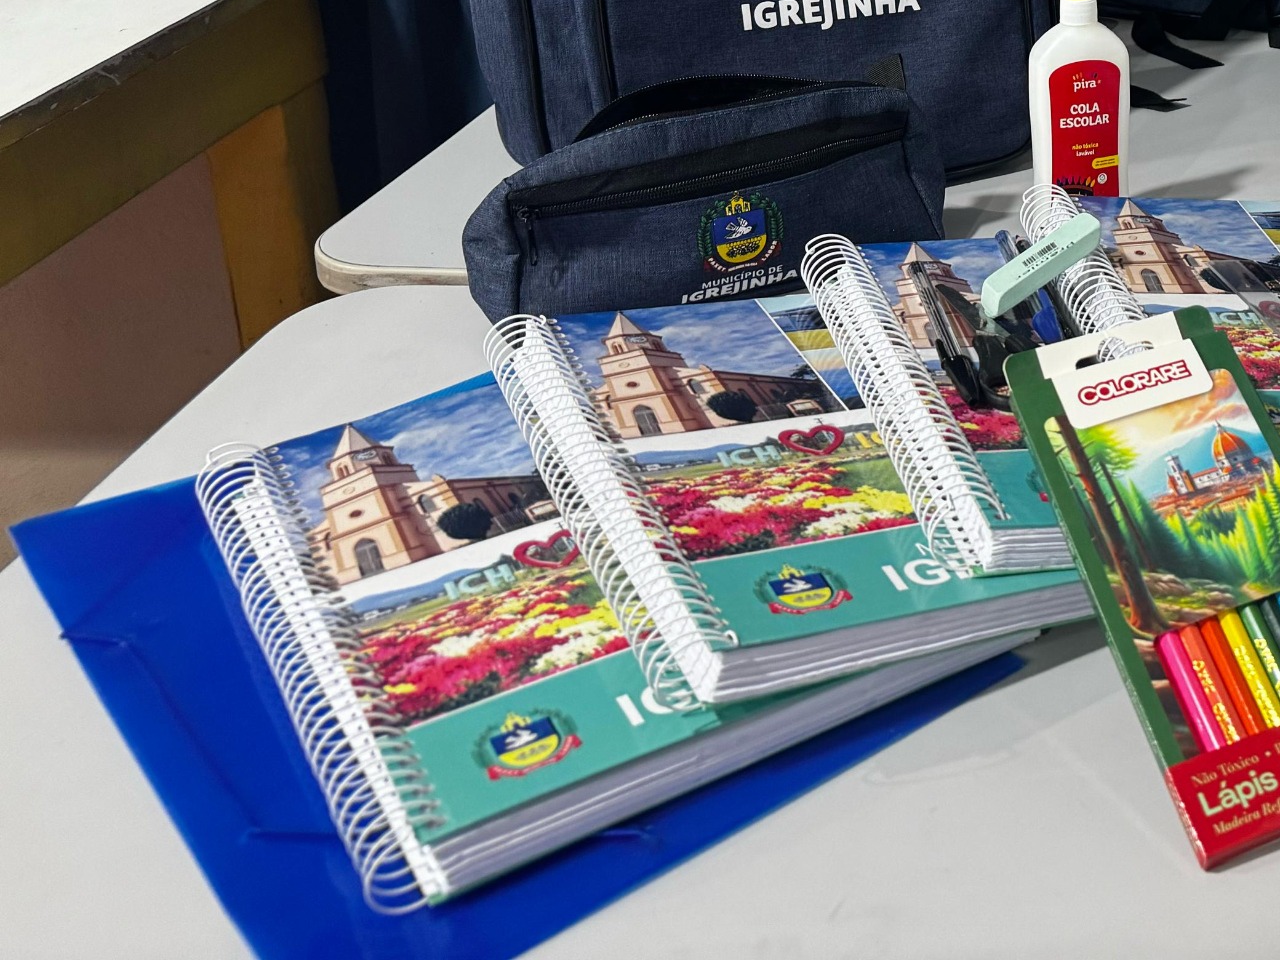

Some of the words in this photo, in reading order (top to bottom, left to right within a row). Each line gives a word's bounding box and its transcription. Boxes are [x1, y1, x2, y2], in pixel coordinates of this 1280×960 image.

[1073, 79, 1096, 92] pira
[1060, 114, 1110, 129] ESCOLAR
[1070, 102, 1100, 115] COLA
[681, 269, 798, 304] IGREJINHA
[701, 269, 764, 290] MUNICÍPIO
[769, 264, 784, 273] DE
[1078, 360, 1192, 405] COLORARE
[717, 445, 782, 467] ICH
[443, 563, 515, 600] ICH
[1191, 772, 1217, 787] Não
[1217, 754, 1260, 777] Tóxico
[1198, 770, 1278, 817] Lápis
[1212, 809, 1261, 836] Madeira
